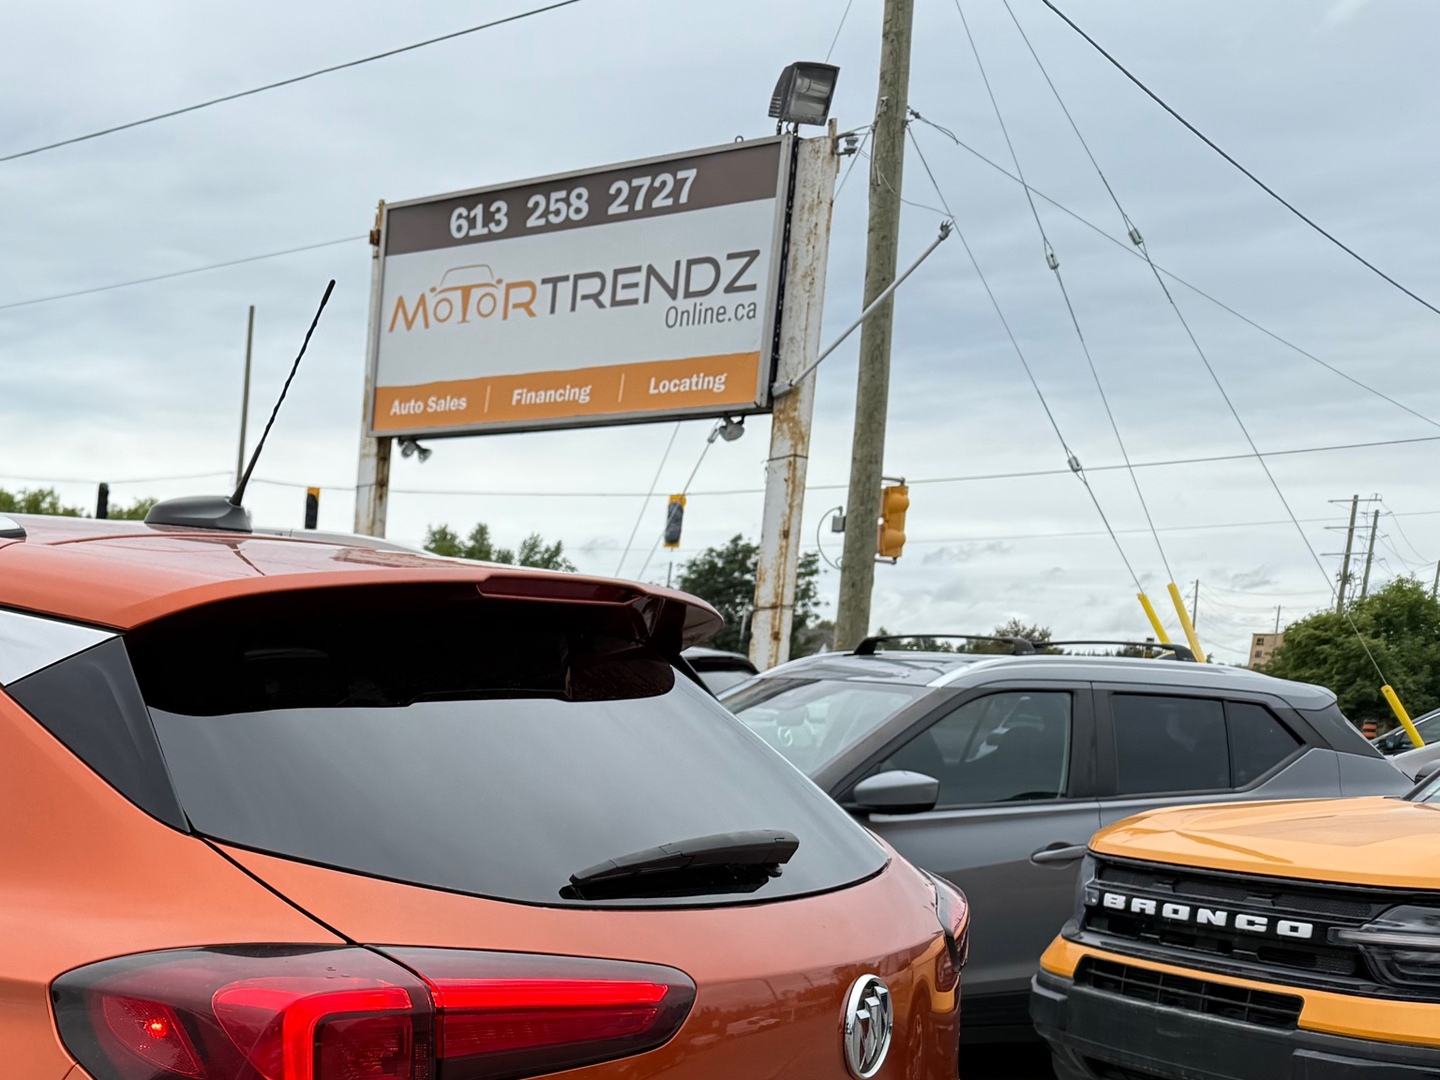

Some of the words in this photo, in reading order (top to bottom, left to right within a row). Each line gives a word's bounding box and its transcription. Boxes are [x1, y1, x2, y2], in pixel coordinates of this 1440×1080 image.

[450, 200, 508, 239] 613
[526, 186, 589, 228] 258
[607, 168, 698, 216] 2727
[665, 300, 758, 329] Online.ca
[512, 383, 592, 405] Financing
[649, 372, 727, 395] Locating
[390, 396, 424, 416] Auto
[426, 394, 467, 414] Sales
[1103, 892, 1313, 939] BRONCO
